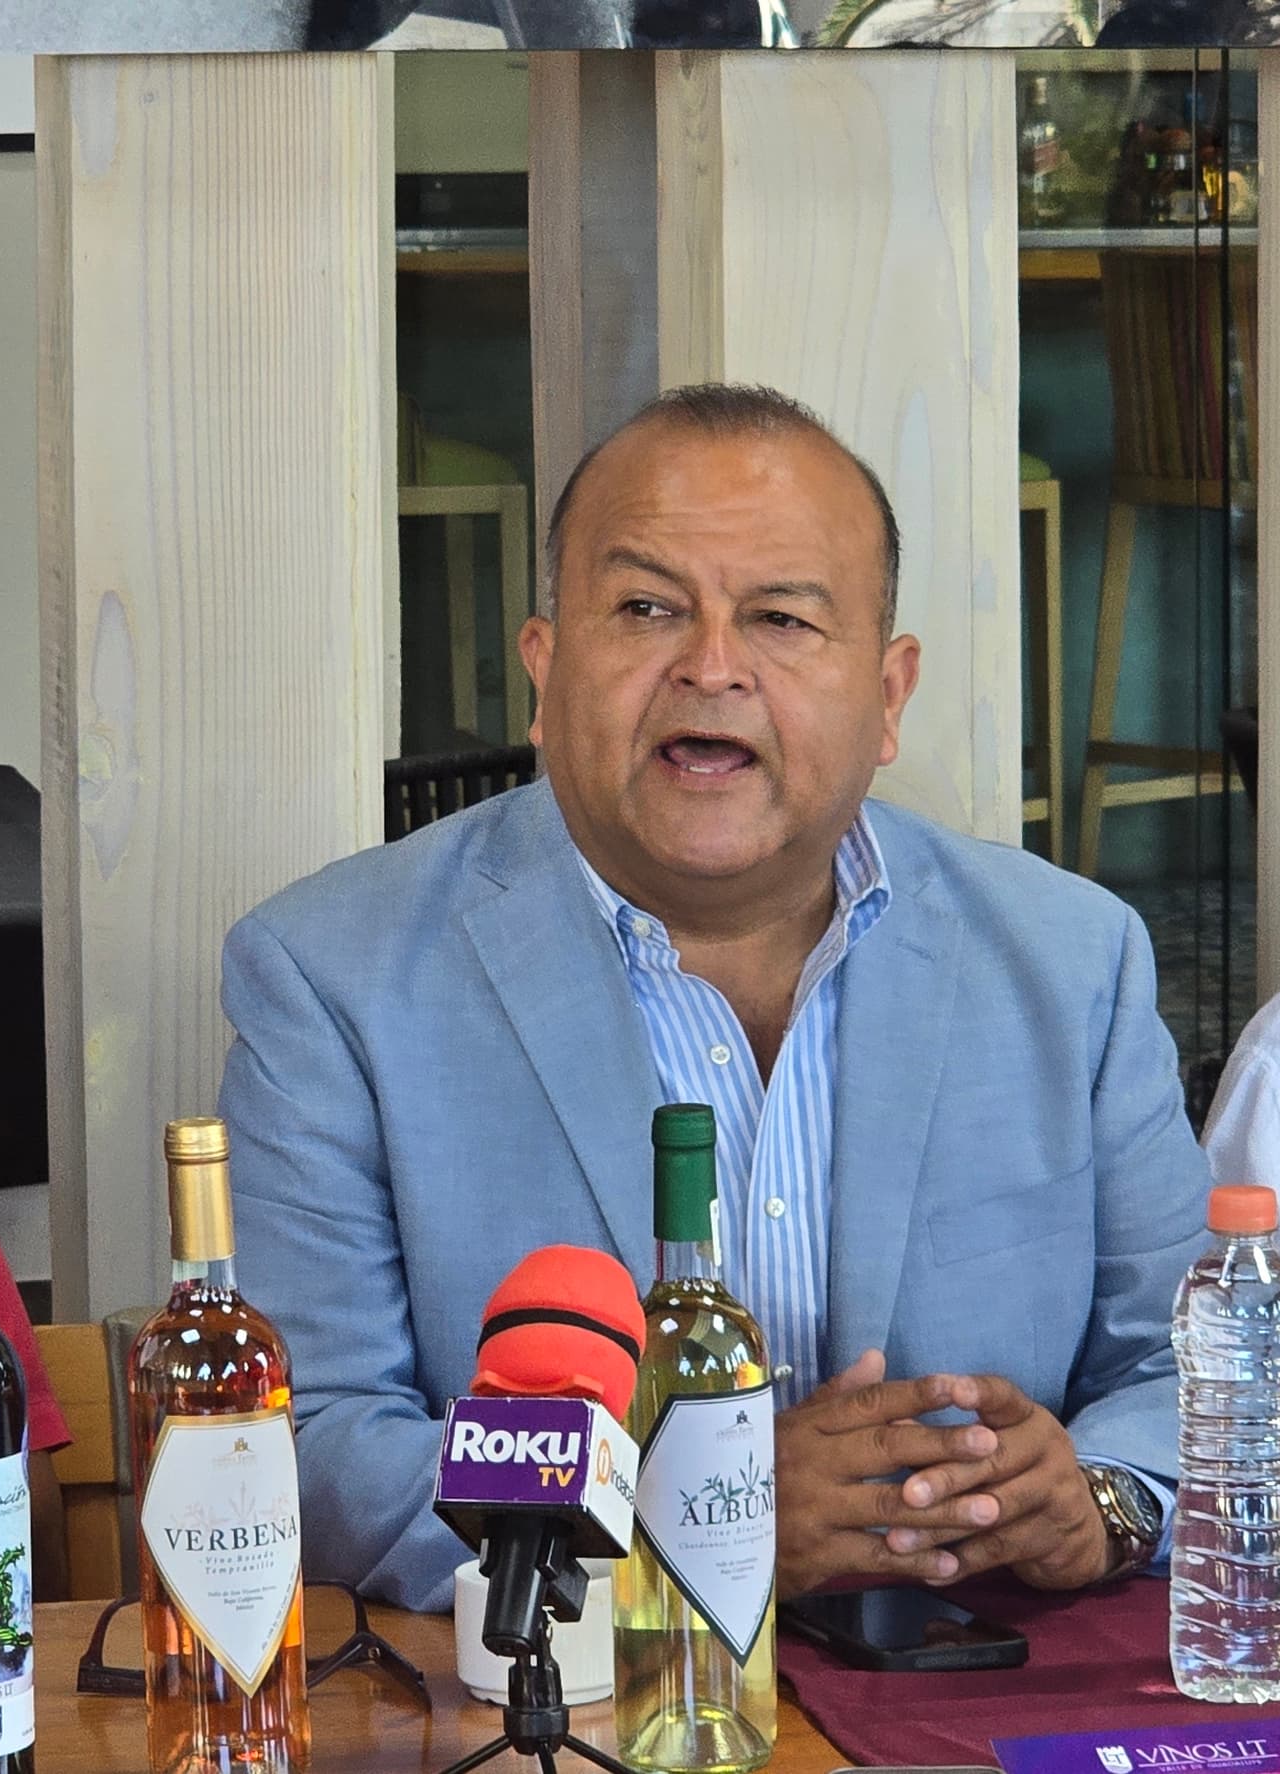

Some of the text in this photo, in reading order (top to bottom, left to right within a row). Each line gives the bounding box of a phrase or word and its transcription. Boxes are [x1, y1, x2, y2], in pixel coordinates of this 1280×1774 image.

[539, 1467, 576, 1487] TV
[164, 1515, 298, 1551] VERBENA
[4, 1683, 14, 1695] LT
[1135, 1739, 1267, 1764] VINOS LT
